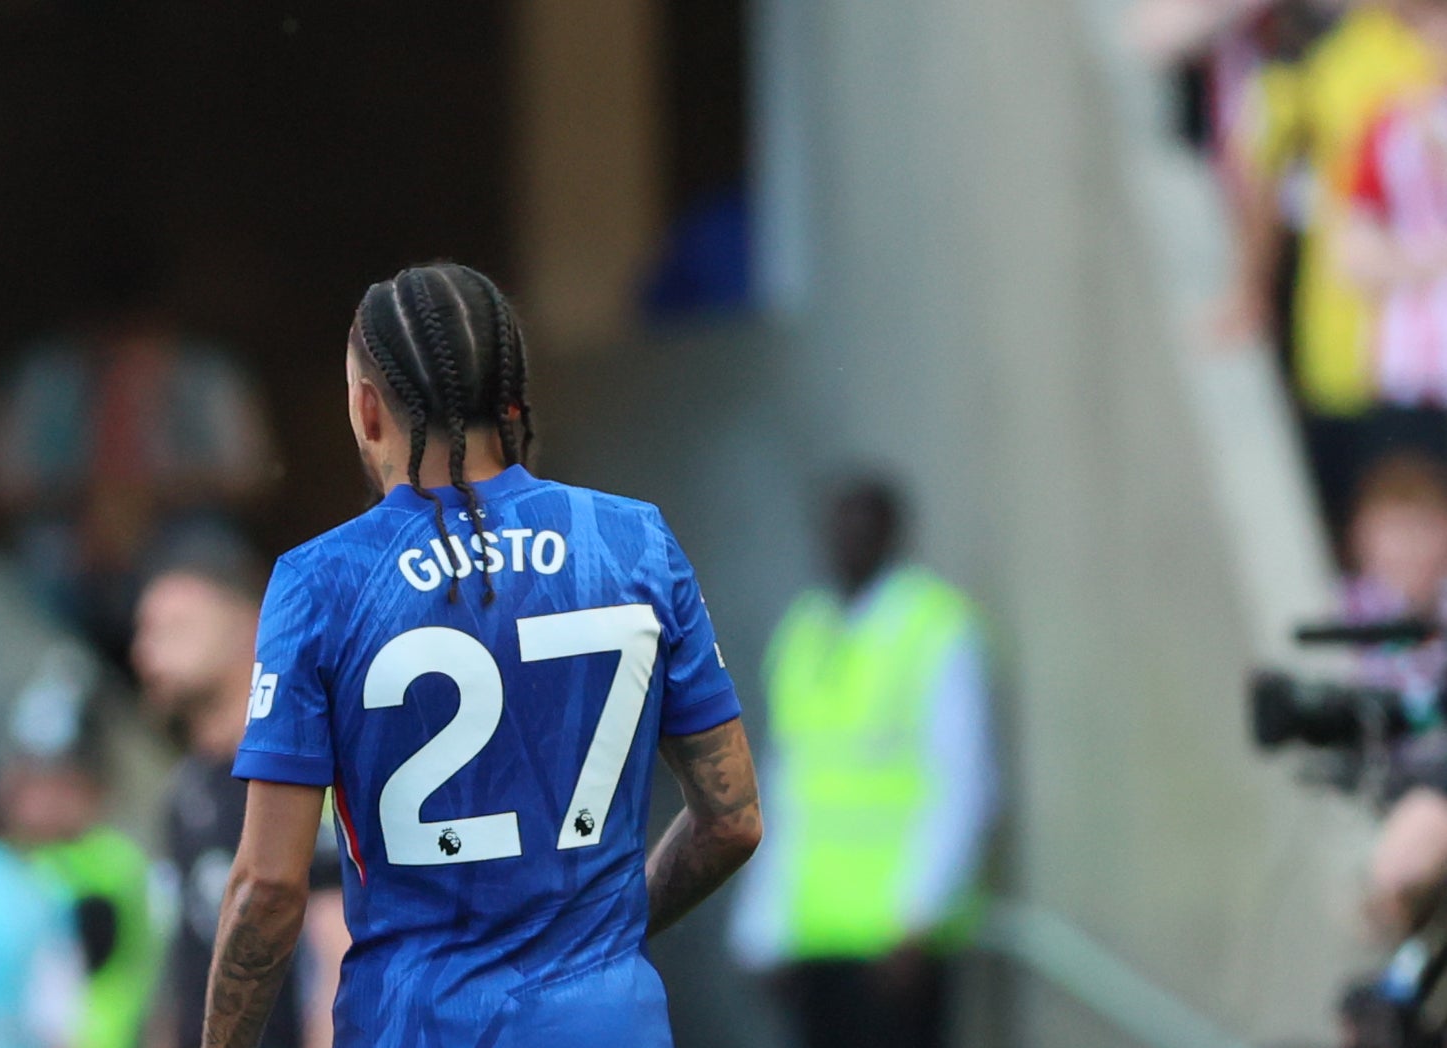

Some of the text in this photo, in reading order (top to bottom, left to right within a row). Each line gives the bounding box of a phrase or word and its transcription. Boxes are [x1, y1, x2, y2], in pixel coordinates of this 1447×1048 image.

[458, 508, 487, 521] CC
[398, 528, 566, 592] GUSTO
[363, 604, 662, 867] 27
